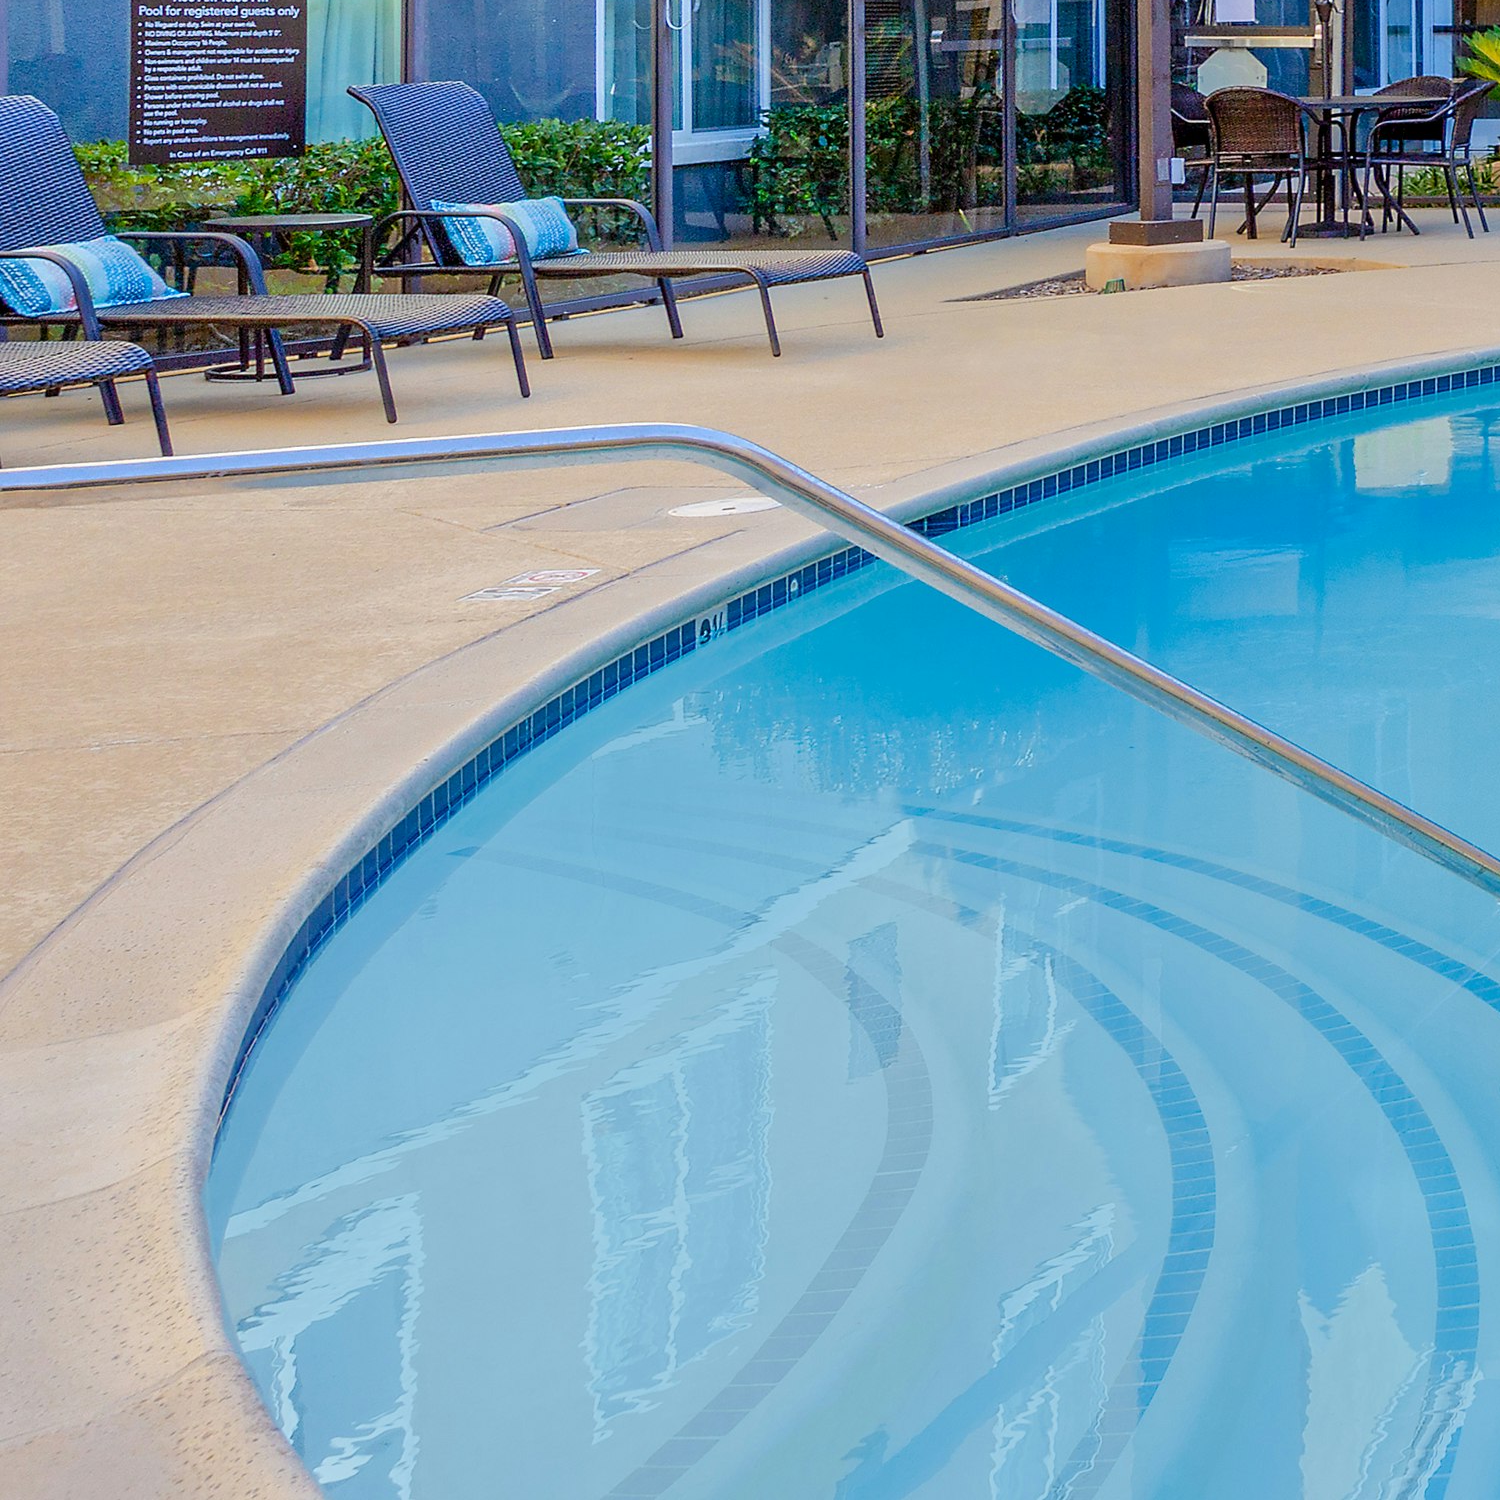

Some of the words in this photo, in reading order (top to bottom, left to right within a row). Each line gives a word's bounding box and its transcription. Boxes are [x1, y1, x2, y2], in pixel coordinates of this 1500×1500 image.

[139, 5, 163, 16] Pool
[165, 5, 182, 16] for
[183, 5, 239, 19] registered
[240, 7, 276, 19] guests
[277, 5, 300, 19] only
[210, 149, 245, 157] Emergency
